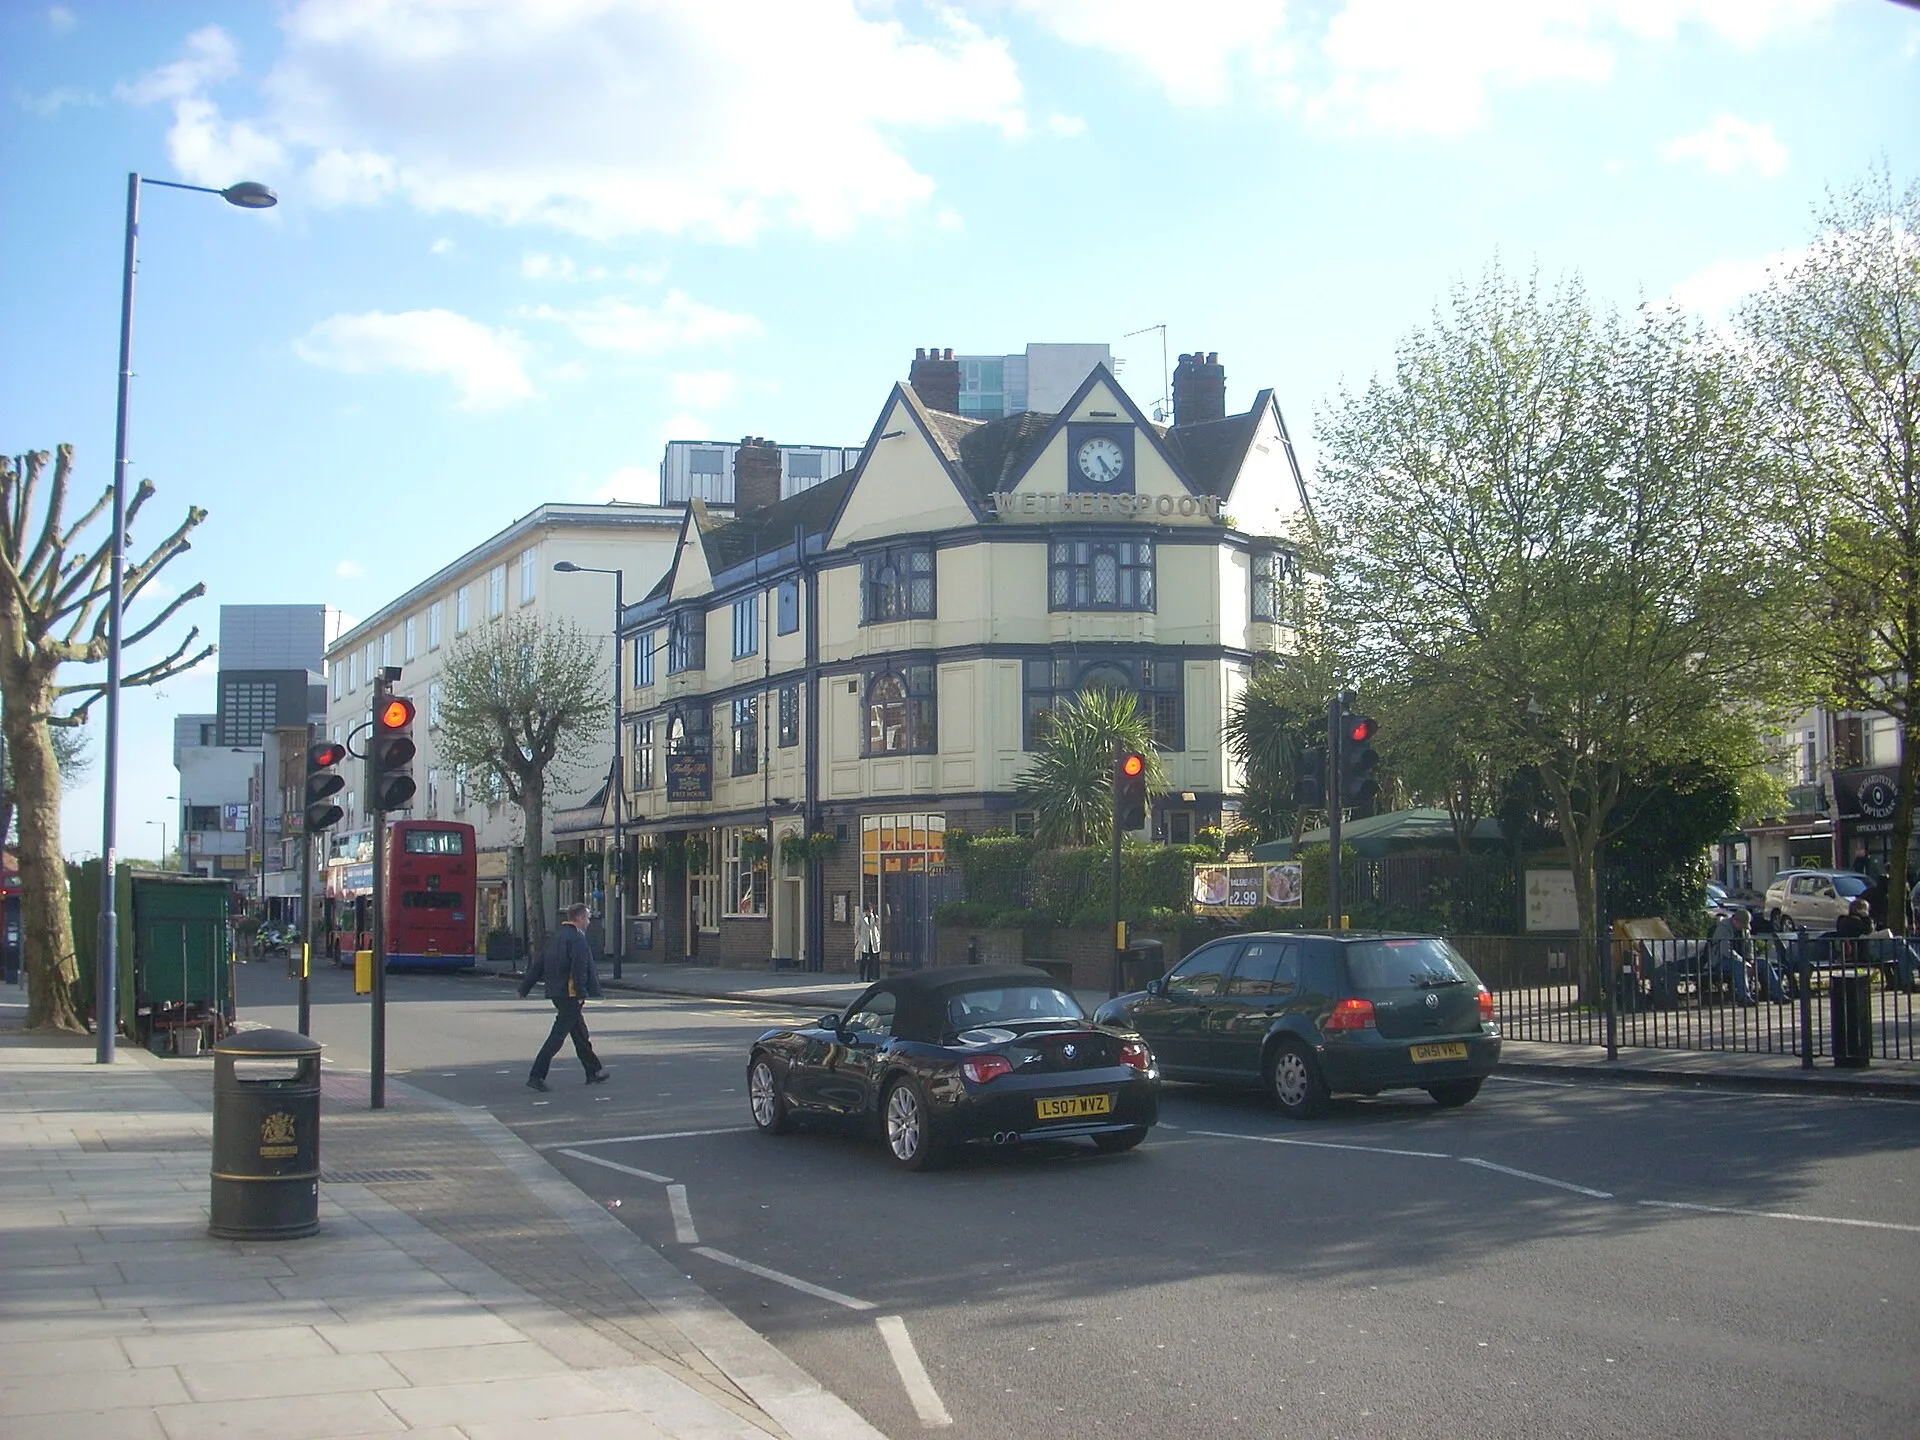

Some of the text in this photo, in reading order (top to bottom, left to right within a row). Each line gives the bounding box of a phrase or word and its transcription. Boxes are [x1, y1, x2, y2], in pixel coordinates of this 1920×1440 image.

[993, 491, 1216, 518] WETHERSPOON
[1230, 891, 1257, 905] £2.99
[1024, 1054, 1043, 1064] Z4
[1043, 1097, 1104, 1116] LS07 WVZ
